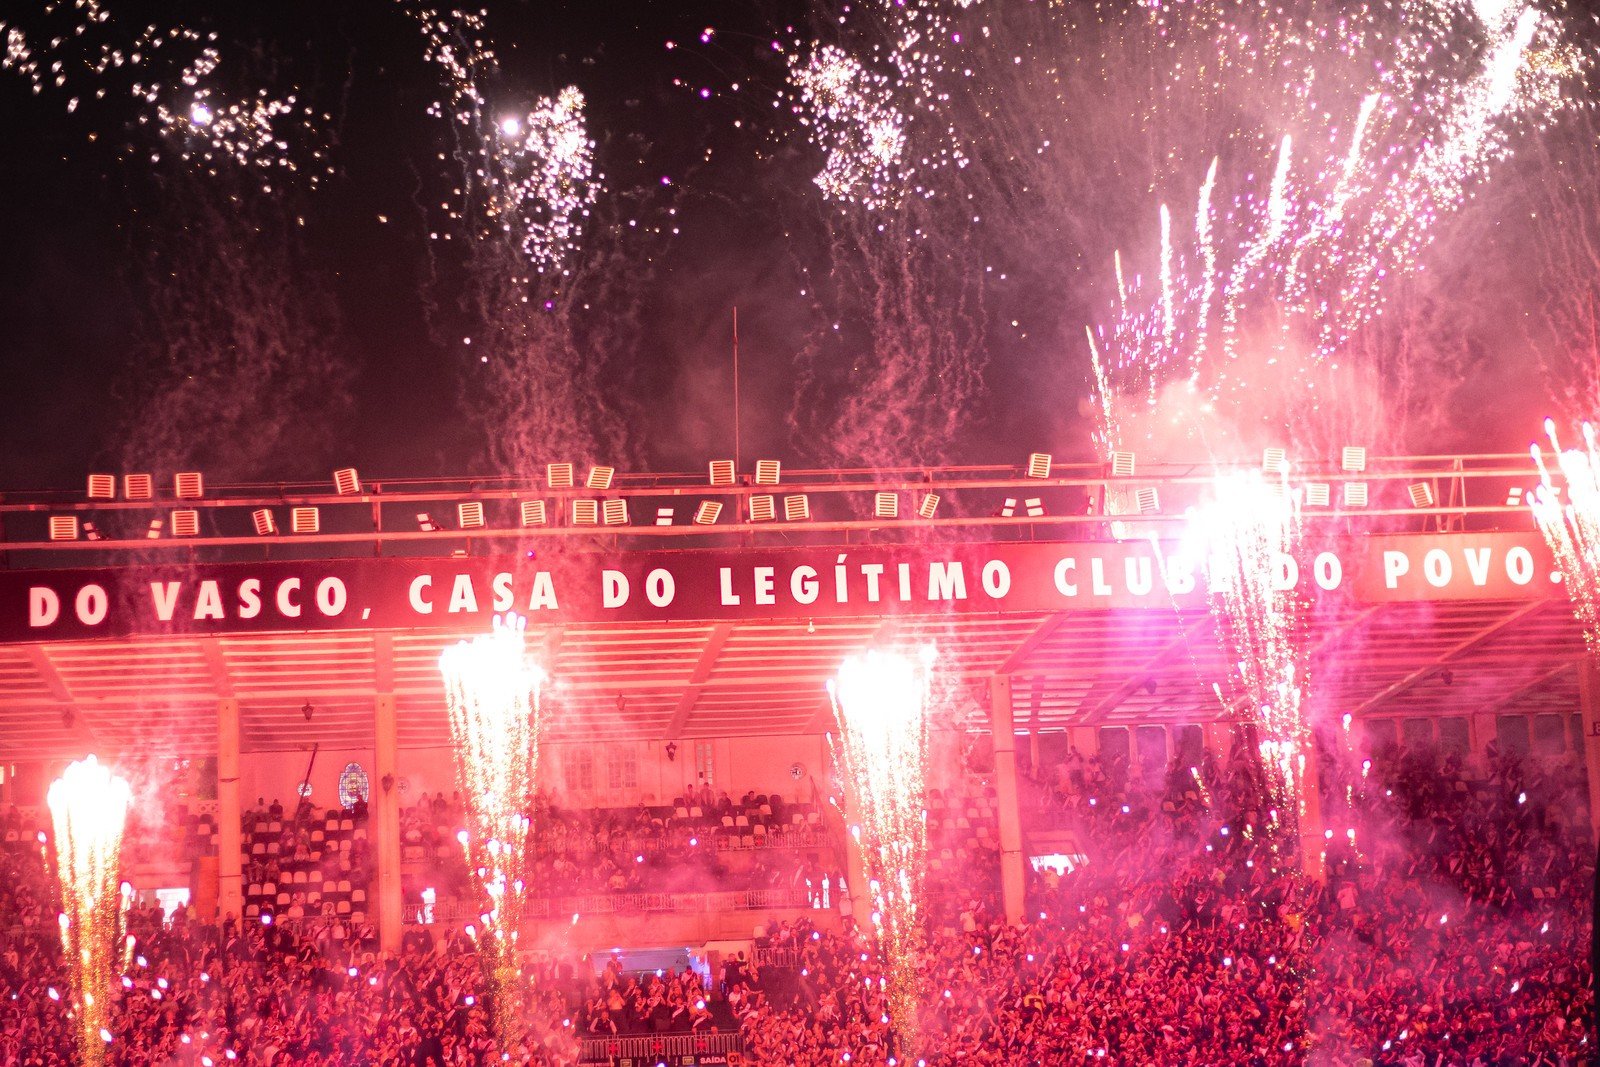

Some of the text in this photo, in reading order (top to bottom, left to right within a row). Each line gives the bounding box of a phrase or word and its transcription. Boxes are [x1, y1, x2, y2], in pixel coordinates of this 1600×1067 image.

[30, 585, 108, 627] DO
[151, 576, 371, 620] VASCO,
[409, 572, 559, 614] CASA
[602, 568, 676, 609] DO
[720, 553, 1012, 606] LEGÍTIMO
[1269, 551, 1342, 592] DO
[1384, 546, 1563, 589] POVO.
[700, 1056, 727, 1064] SAÍDA
